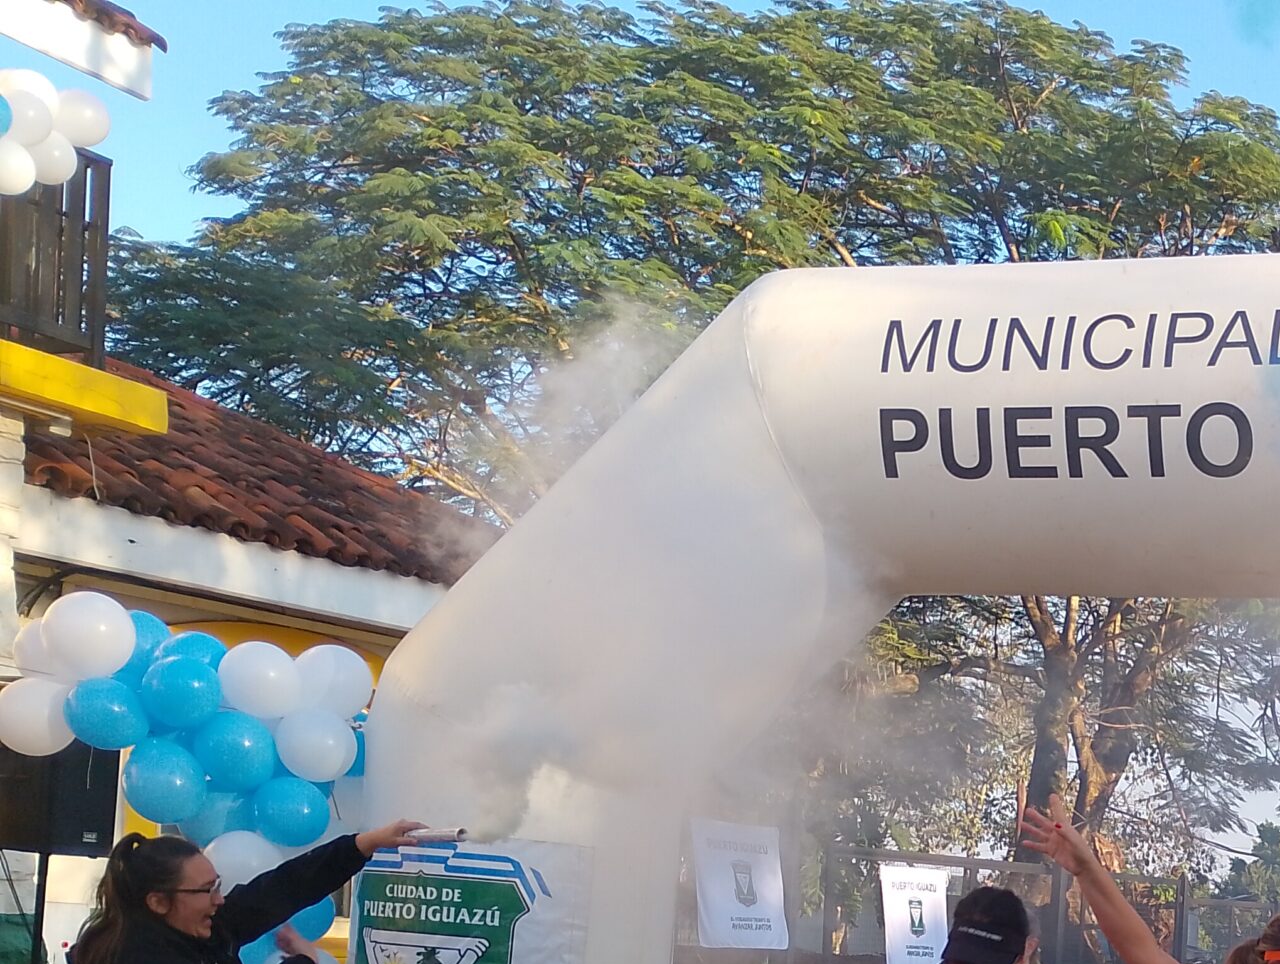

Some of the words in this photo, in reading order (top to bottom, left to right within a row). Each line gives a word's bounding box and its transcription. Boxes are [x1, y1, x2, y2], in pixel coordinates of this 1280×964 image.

[878, 401, 1254, 479] PUERTO
[386, 883, 438, 900] CIUDAD
[441, 888, 463, 902] DE
[363, 900, 417, 920] PUERTO
[420, 905, 501, 927] IGUAZÚ
